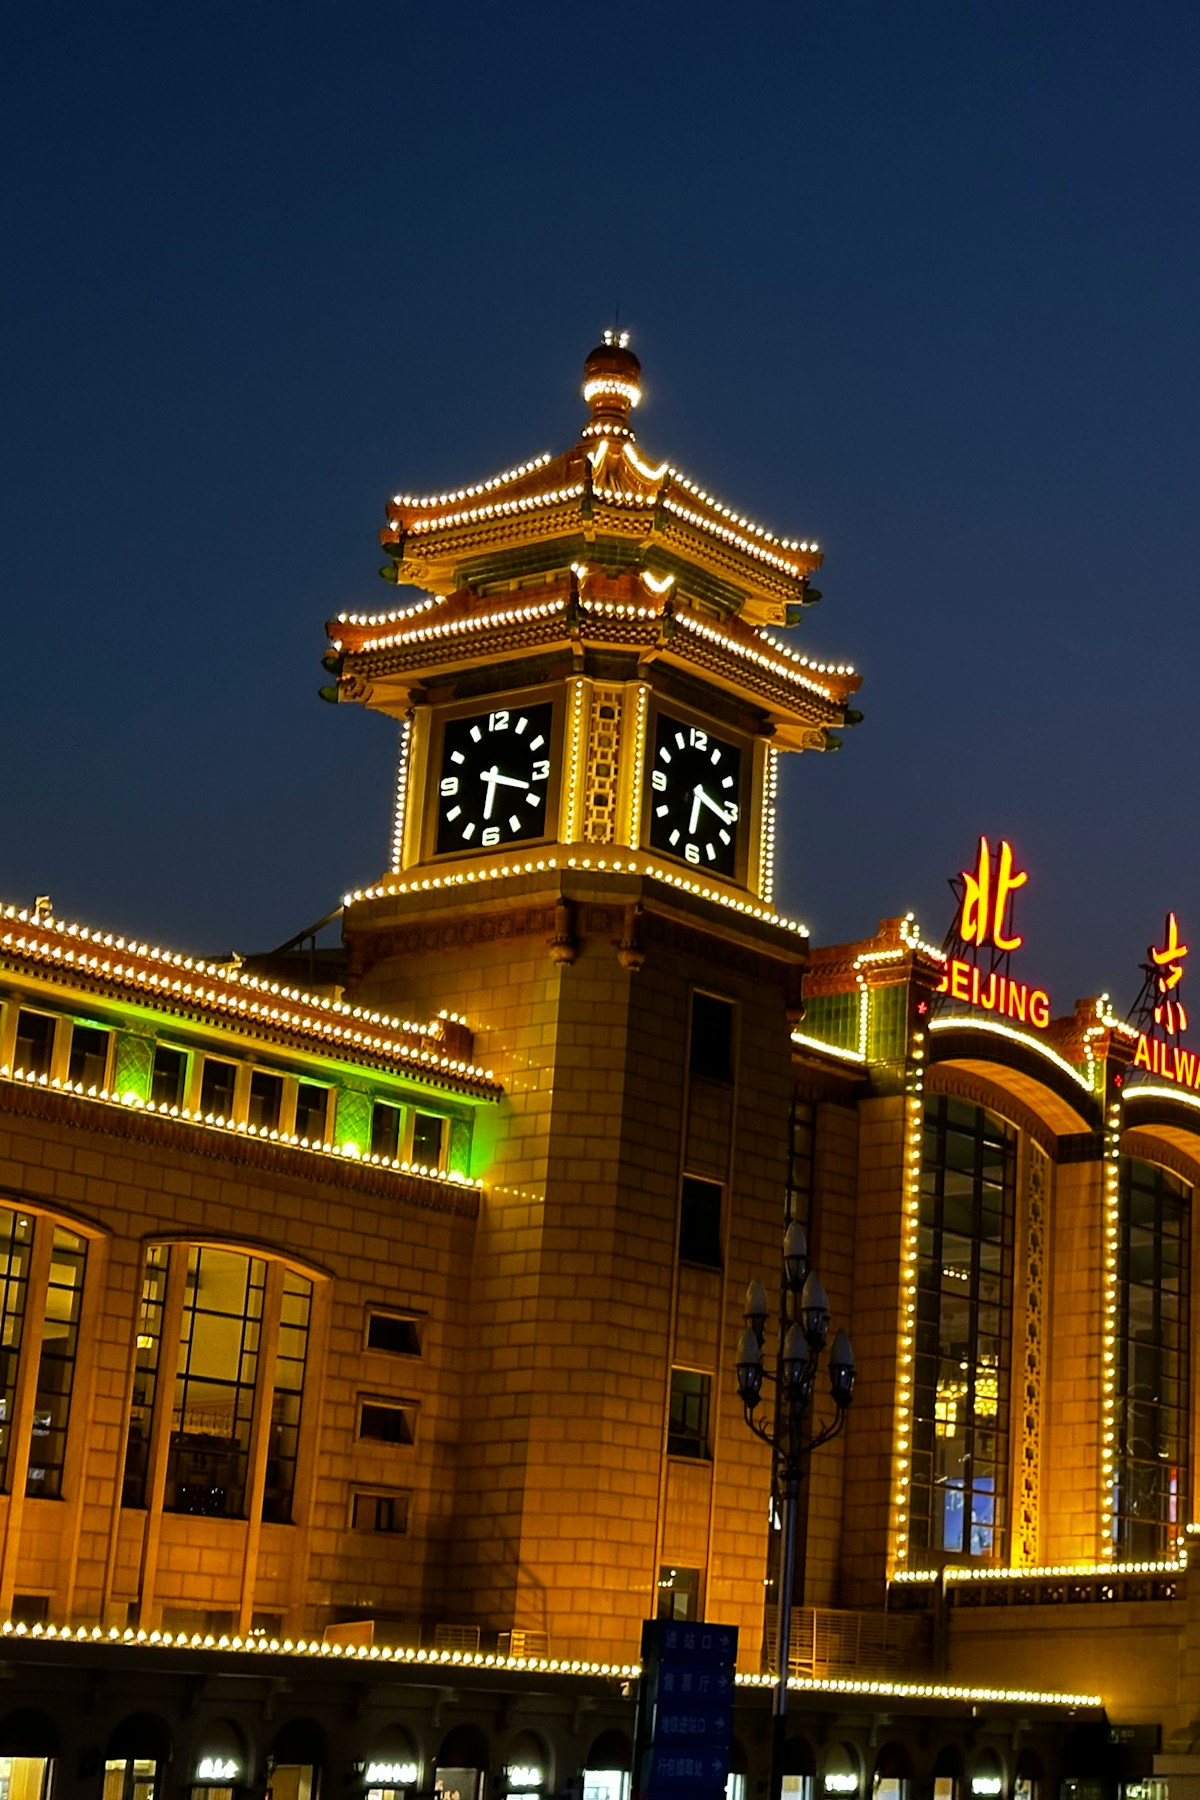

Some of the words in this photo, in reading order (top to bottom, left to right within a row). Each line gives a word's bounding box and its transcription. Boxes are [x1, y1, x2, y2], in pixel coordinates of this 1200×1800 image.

[488, 711, 510, 732] 12
[689, 728, 708, 752] 12
[531, 760, 549, 781] 3
[651, 770, 667, 792] 9
[440, 777, 459, 797] 9
[481, 826, 500, 847] 6
[684, 843, 700, 864] 6
